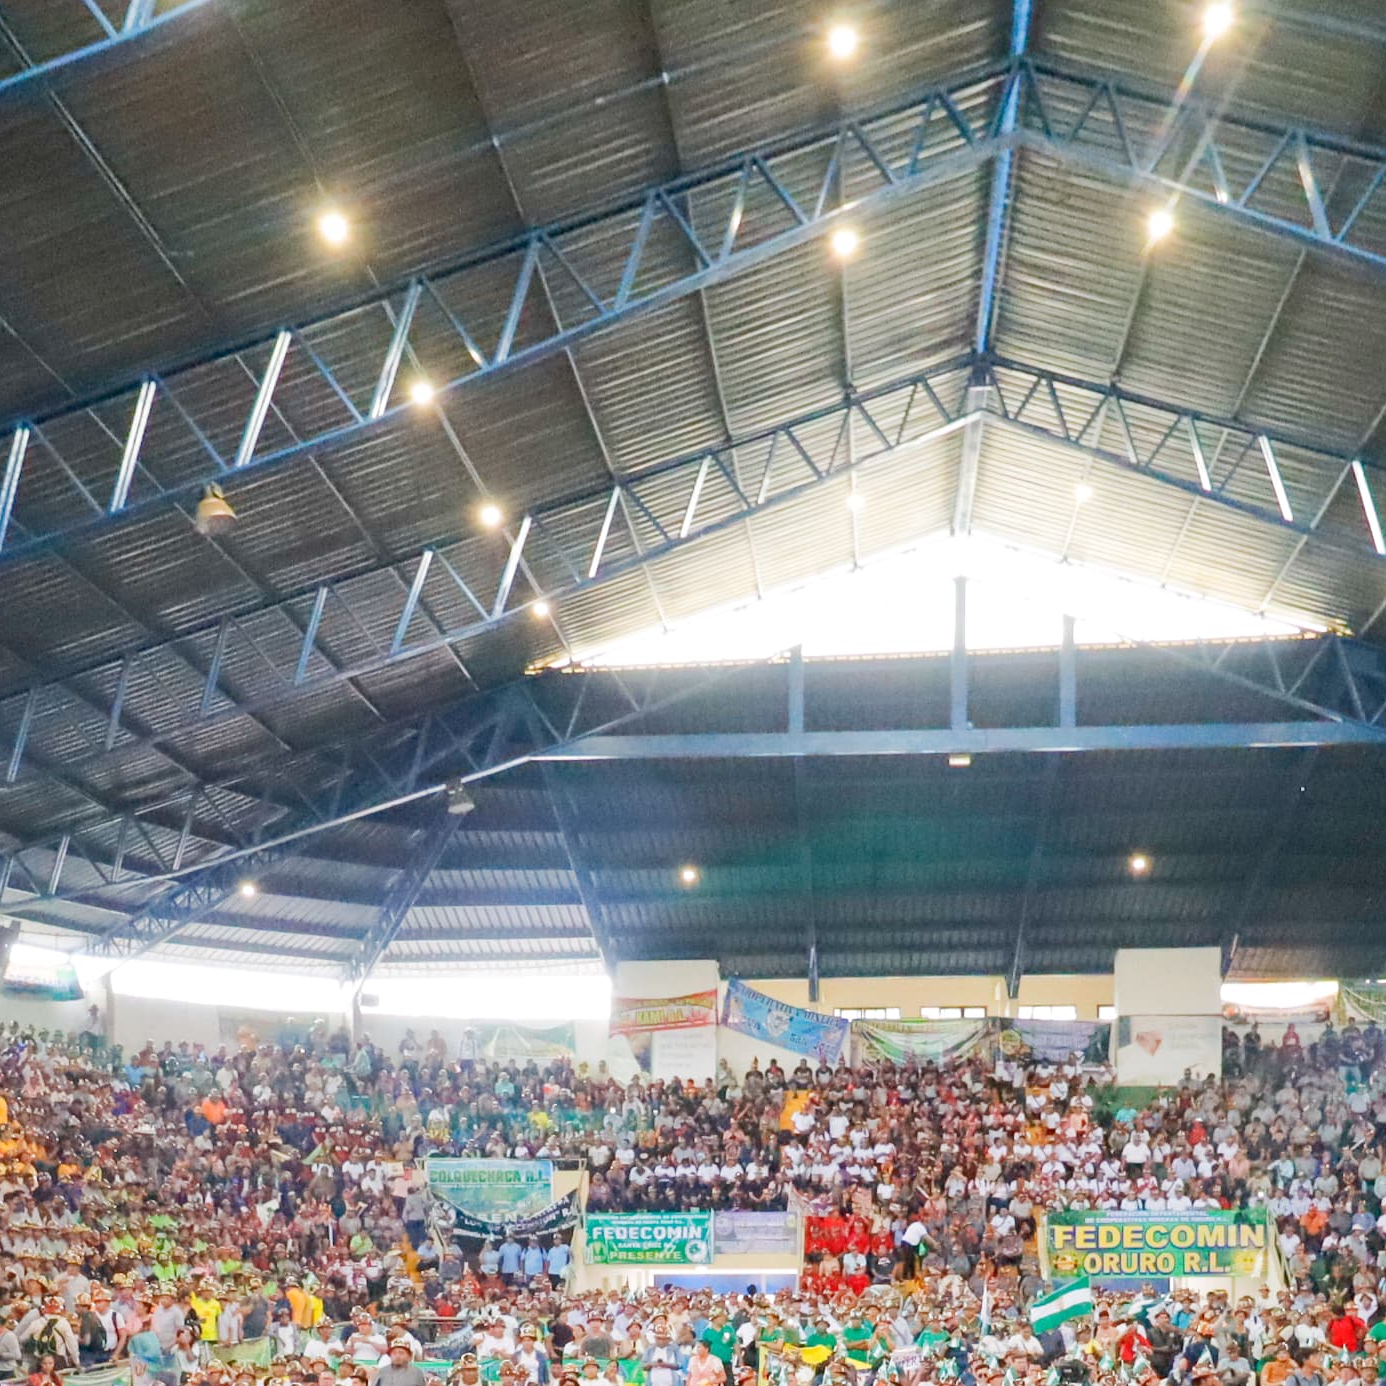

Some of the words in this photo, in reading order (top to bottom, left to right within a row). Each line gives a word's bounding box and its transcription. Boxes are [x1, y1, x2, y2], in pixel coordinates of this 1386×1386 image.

[592, 1226, 702, 1241] FEDECOMIN
[1052, 1224, 1266, 1250] FEDECOMIN
[609, 1250, 682, 1260] PRESENTE
[1082, 1251, 1175, 1275] ORURO
[1183, 1251, 1232, 1274] R.L.
